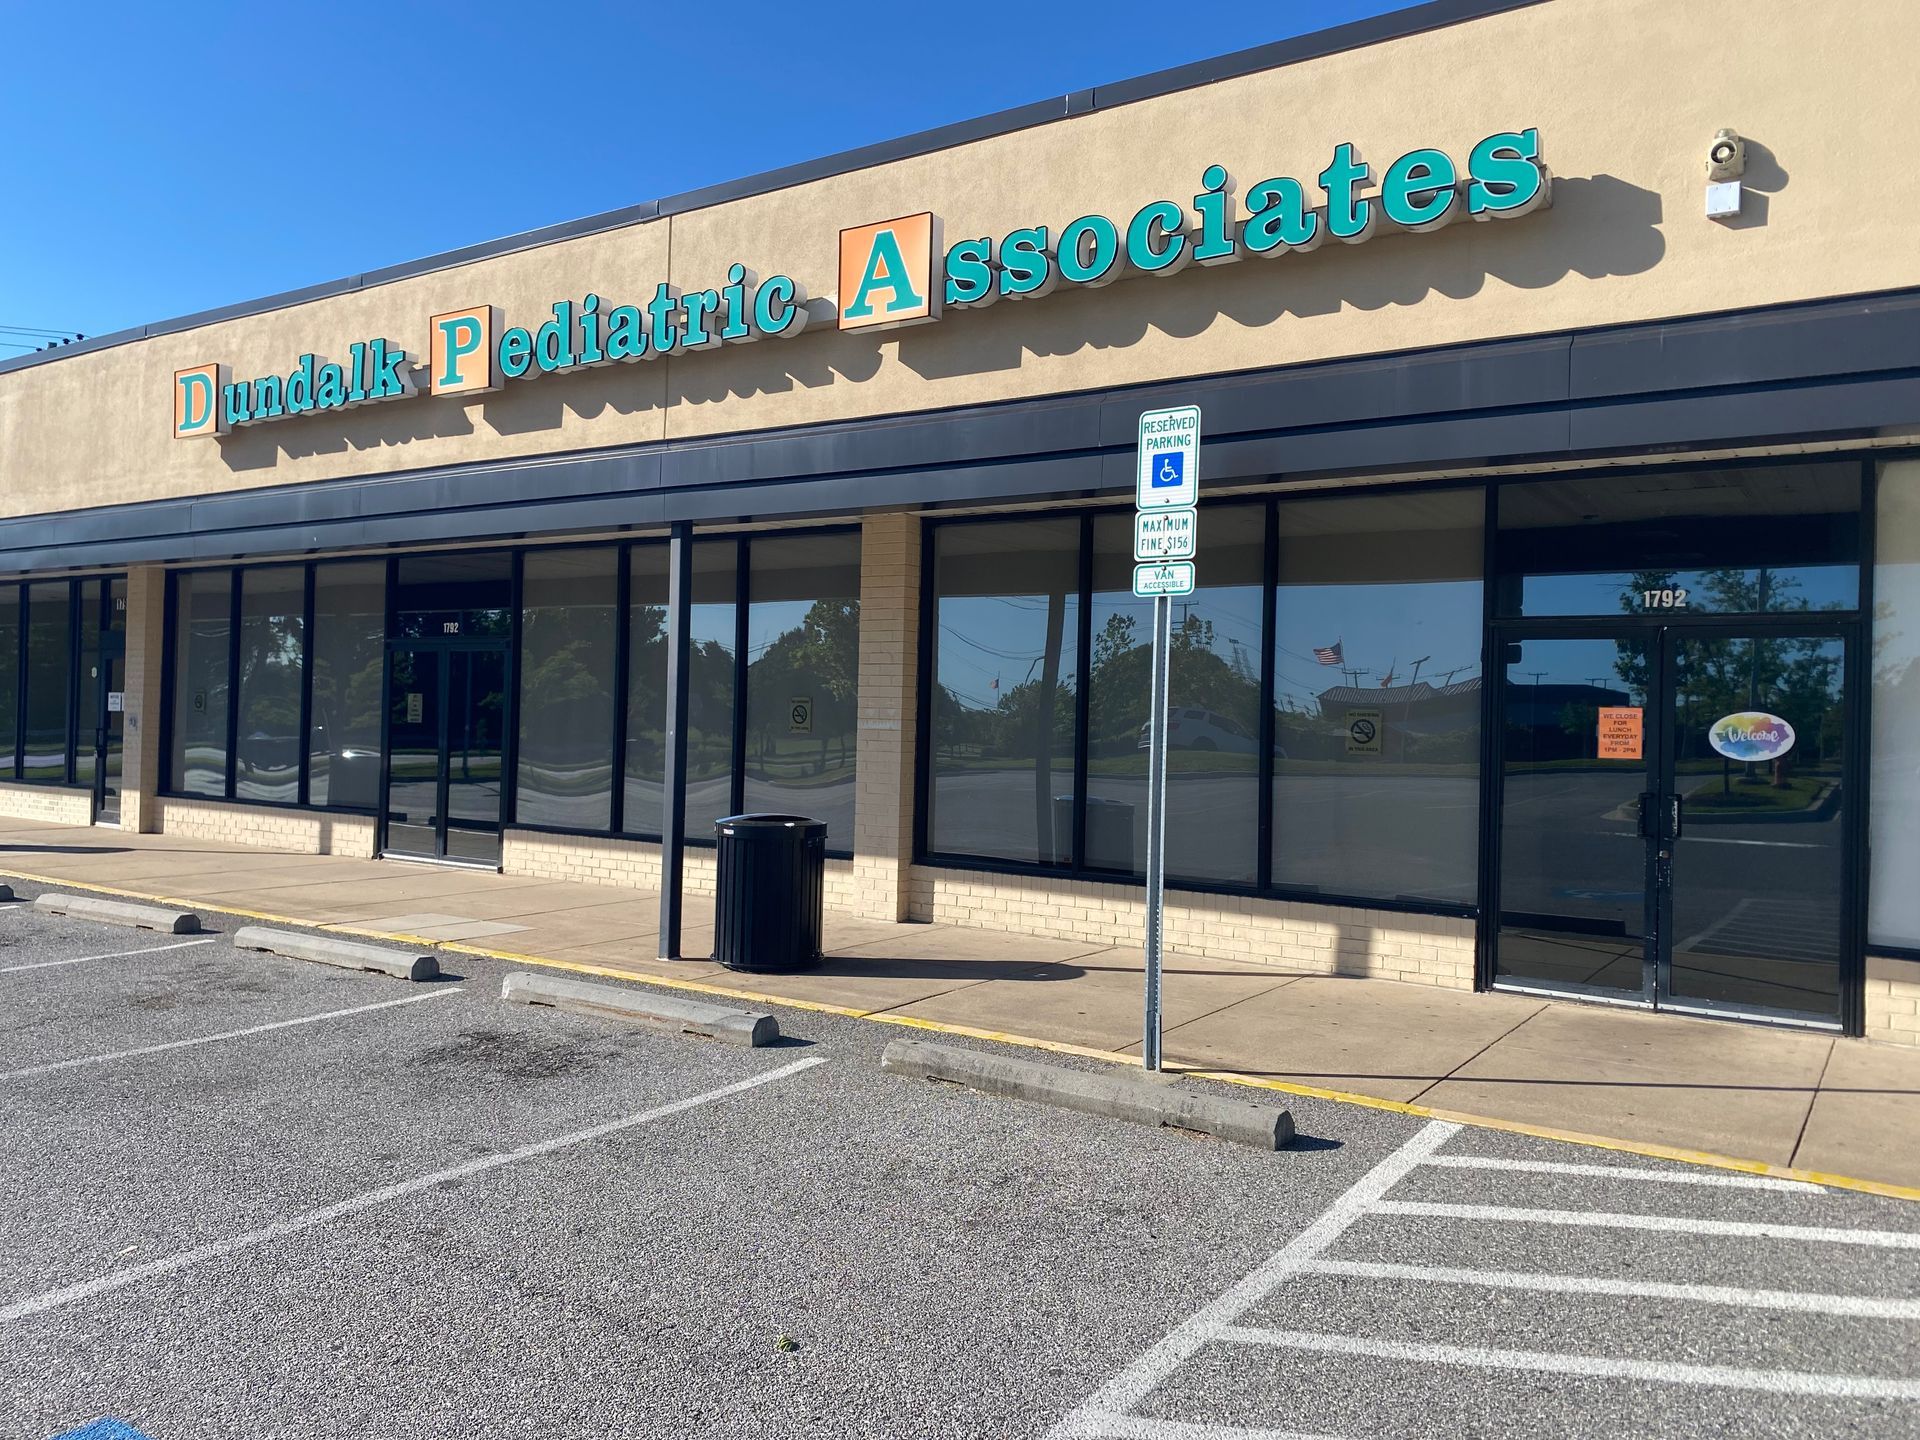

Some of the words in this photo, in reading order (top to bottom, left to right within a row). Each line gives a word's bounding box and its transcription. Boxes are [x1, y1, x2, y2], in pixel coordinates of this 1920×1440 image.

[178, 338, 406, 431] Dundalk
[438, 262, 797, 389] Pediatric
[841, 126, 1541, 322] Associates
[1143, 416, 1196, 434] RESERVED
[1146, 433, 1191, 450] PARKING
[1142, 518, 1189, 533] MAXIMUM
[1141, 537, 1163, 551] FINE
[1167, 536, 1188, 550] $156
[1154, 570, 1174, 580] VAN
[1143, 580, 1184, 589] ACCESSIBLE
[1643, 589, 1687, 608] 1792
[443, 622, 459, 633] 1792
[1719, 725, 1780, 743] Welcome
